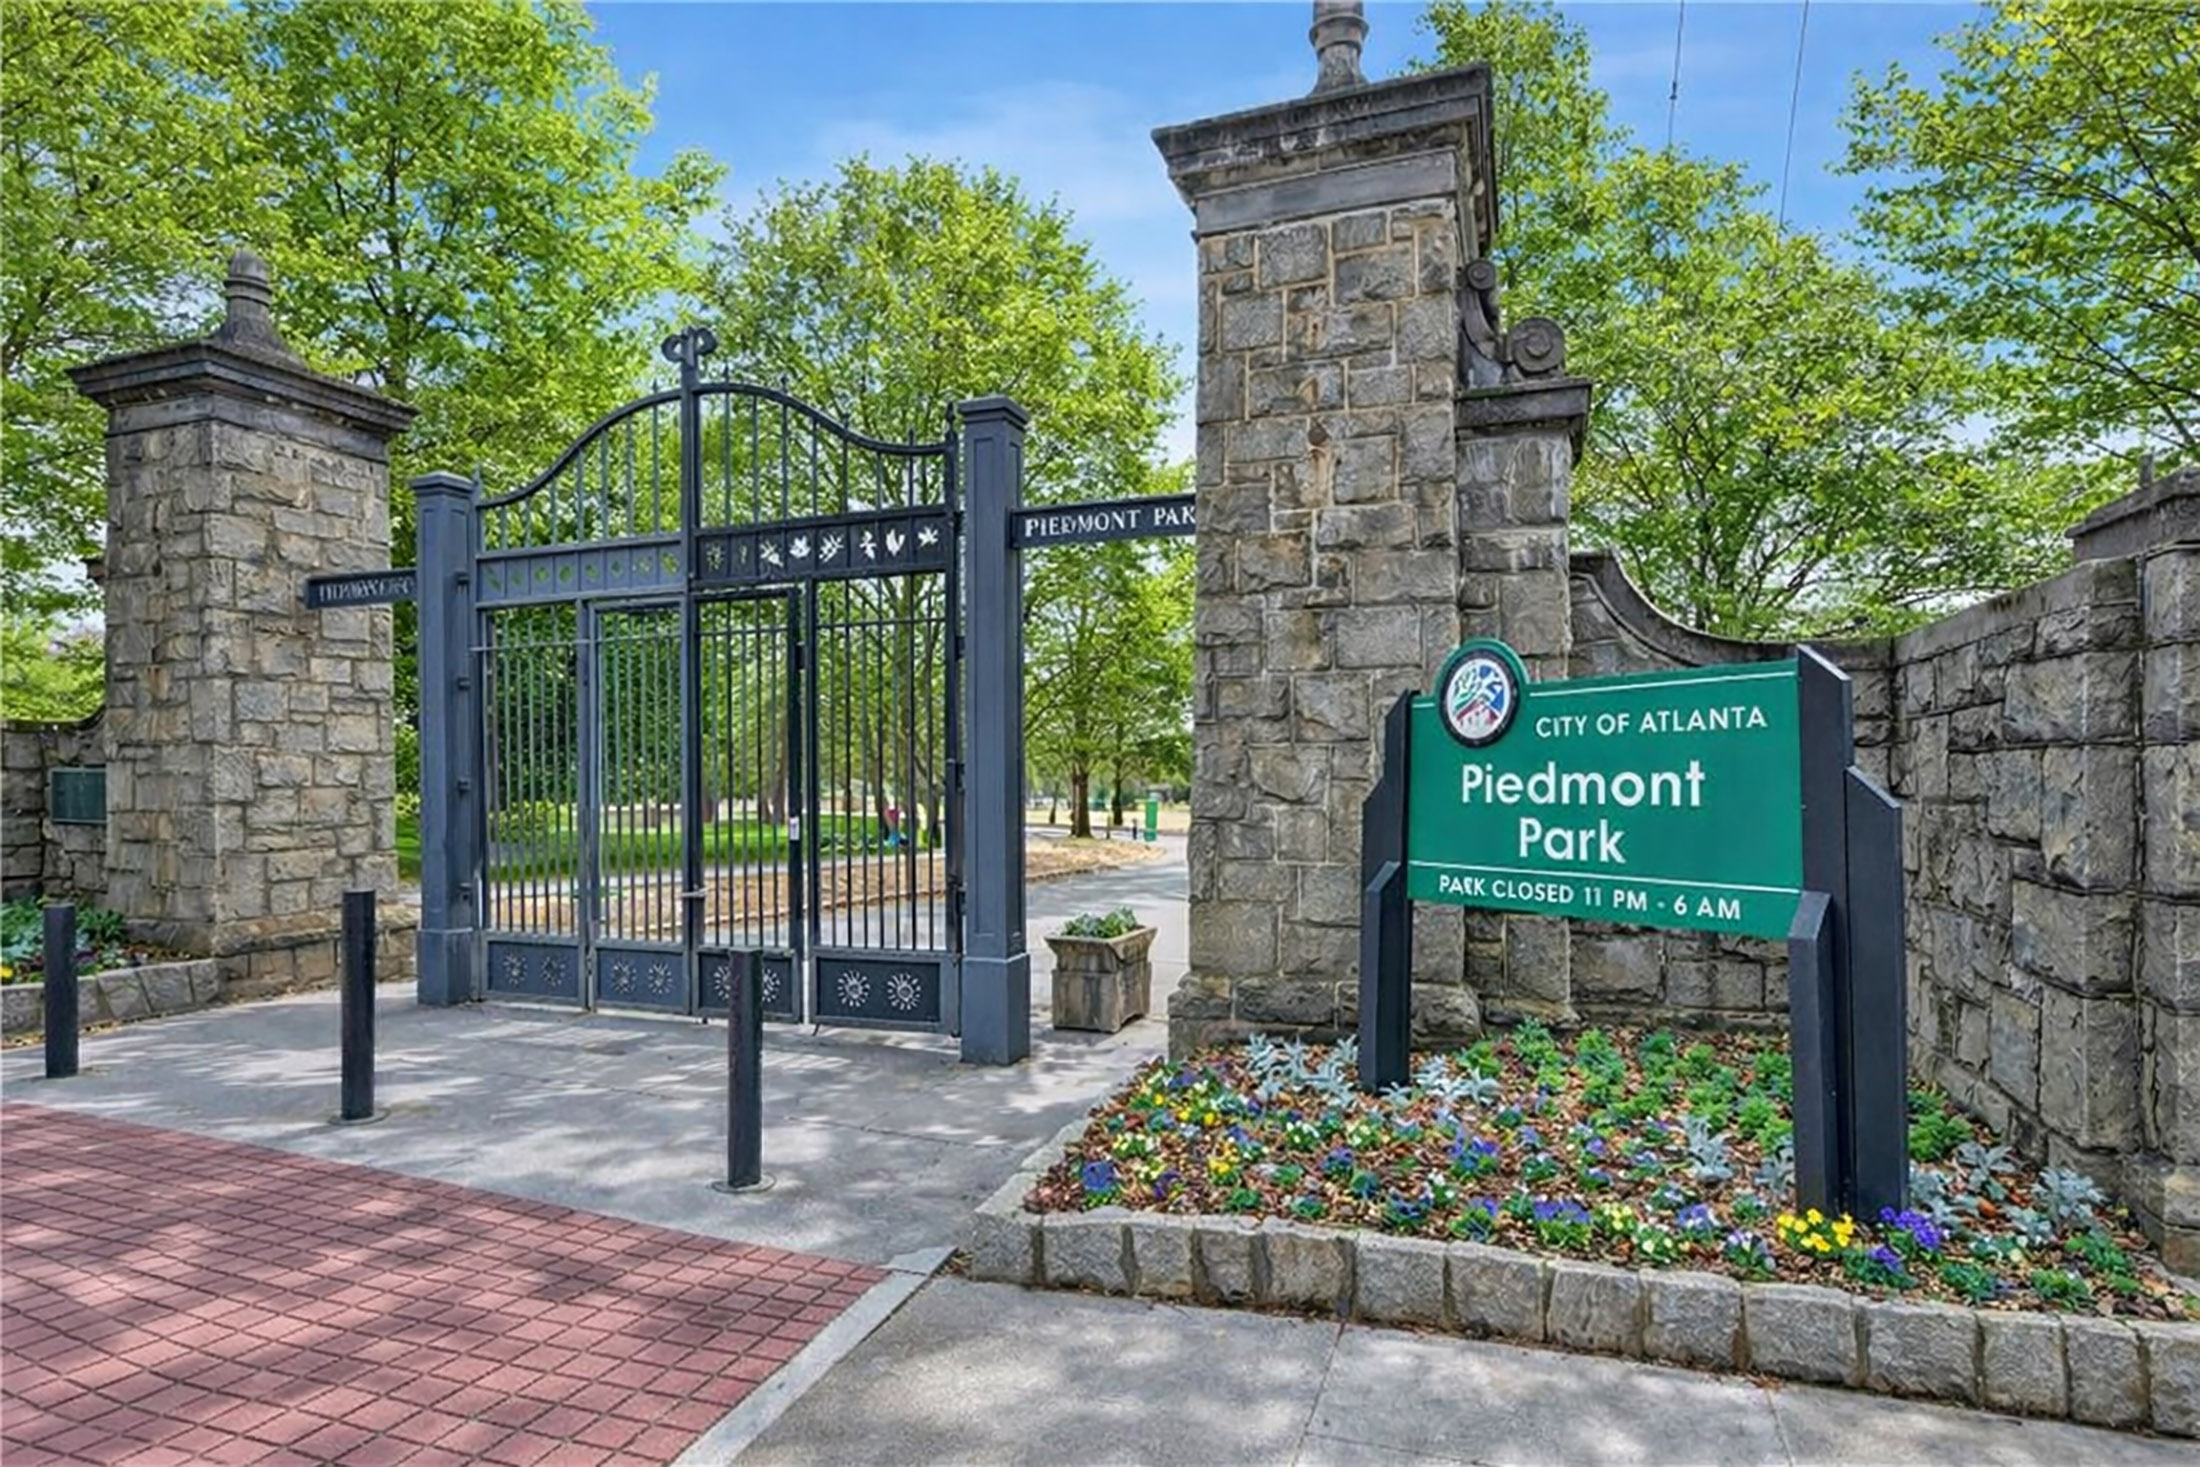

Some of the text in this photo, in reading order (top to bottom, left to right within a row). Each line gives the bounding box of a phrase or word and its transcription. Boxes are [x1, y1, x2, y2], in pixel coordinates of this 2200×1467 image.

[1024, 509, 1141, 537] PIEDMONT
[1535, 706, 1768, 738] CITY OF ATLANTA
[1461, 760, 1705, 807] Piedmont
[1519, 817, 1626, 864] Park
[1439, 874, 1486, 896] PARK
[1492, 879, 1574, 903] CLOSED
[1584, 886, 1602, 906] 11
[1612, 889, 1648, 912] PM
[1672, 894, 1687, 916] 6
[1696, 897, 1741, 920] AM
